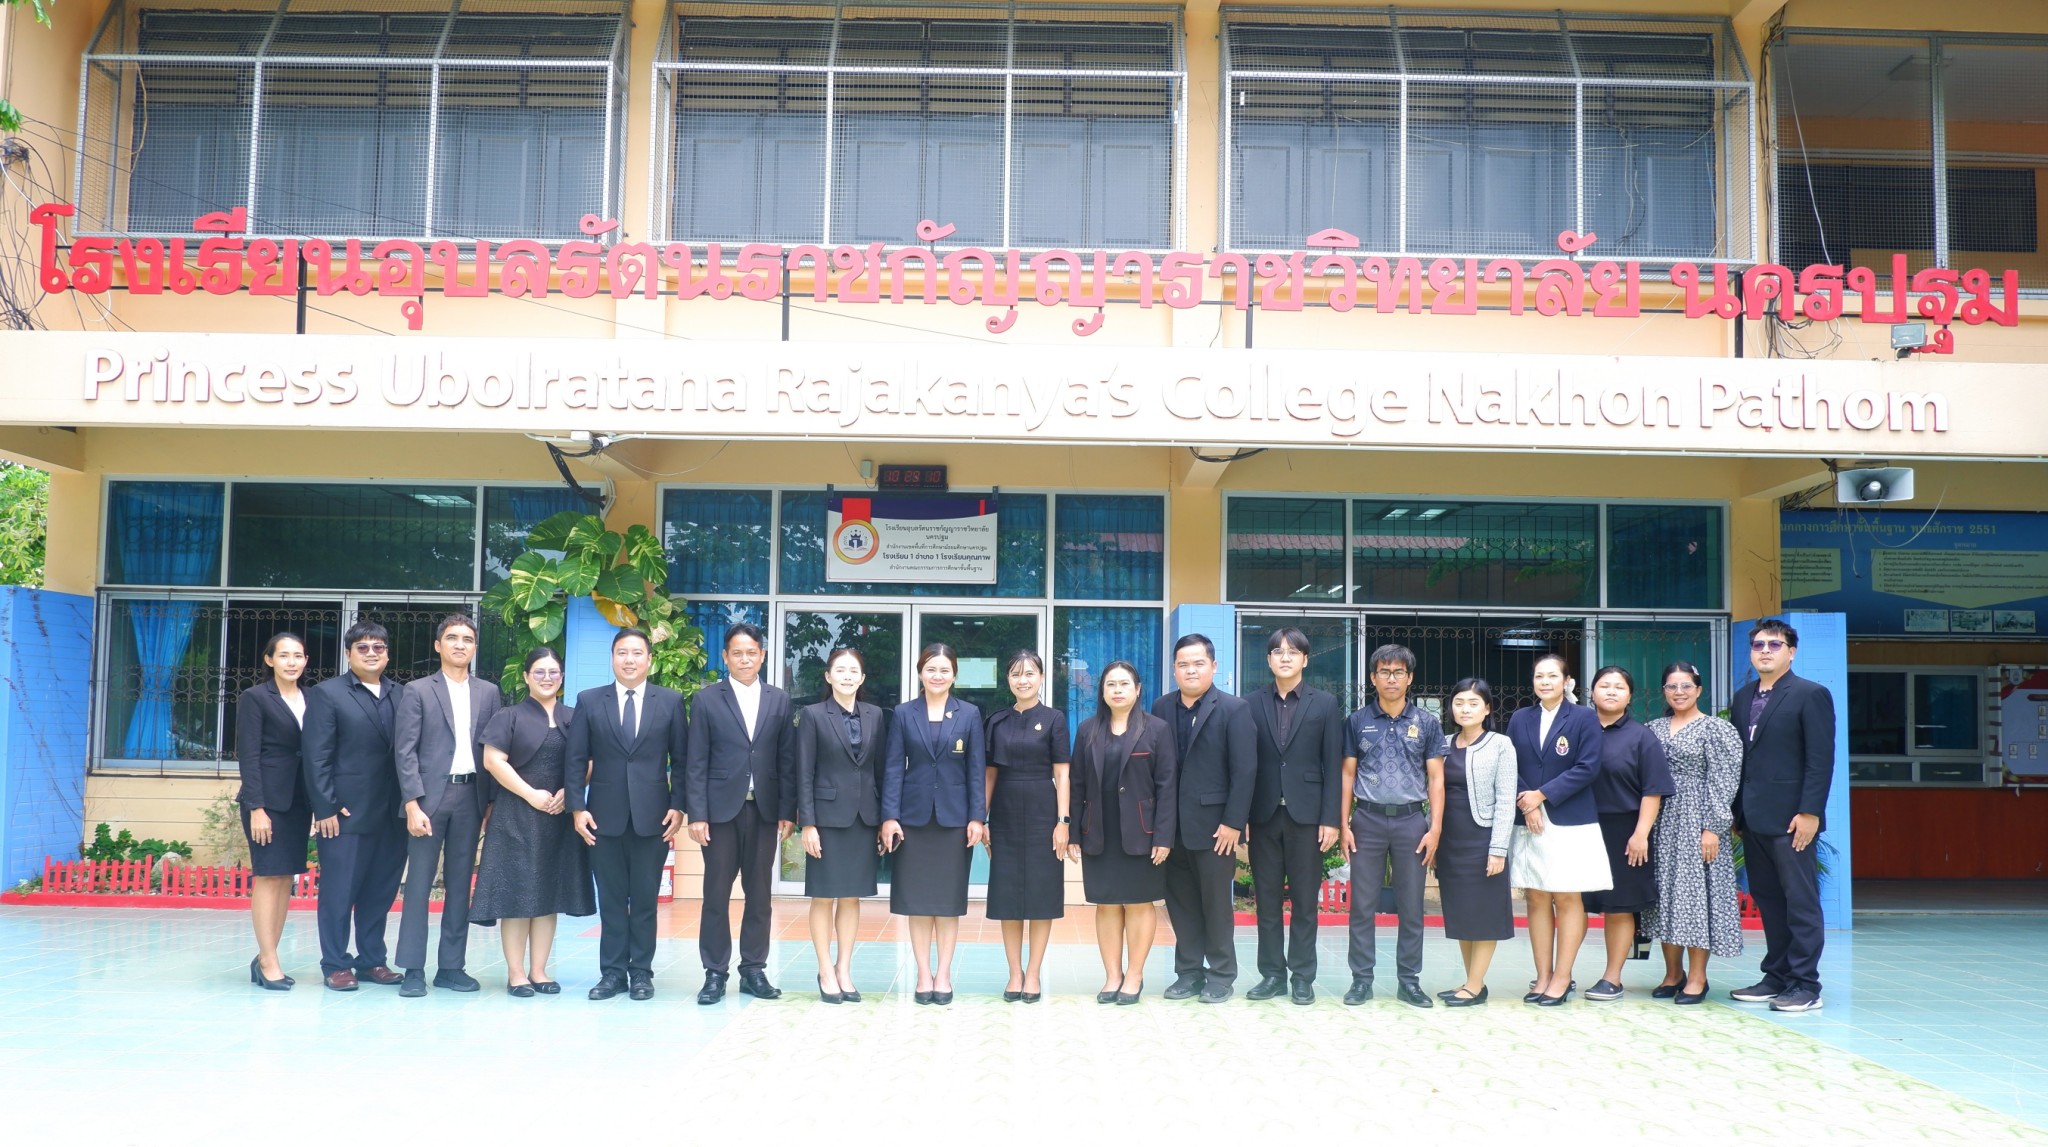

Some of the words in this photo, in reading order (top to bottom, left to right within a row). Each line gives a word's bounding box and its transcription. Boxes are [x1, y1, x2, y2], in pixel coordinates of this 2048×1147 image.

[29, 203, 1641, 336] โรงเรียนอุบลรัตนราชกัญญาราชวิทยาลัย
[1670, 253, 2019, 355] นครปฐม
[83, 347, 359, 406] Princess
[381, 350, 748, 415] Ubolratana
[766, 361, 1140, 431] Rajakanya's
[1161, 364, 1408, 437] College
[1427, 368, 1682, 427] Nakhon
[1699, 371, 1949, 433] Pathom
[1969, 524, 1996, 534] 2551
[926, 534, 949, 542] นครปฐม
[883, 552, 909, 560] โรงเรียน
[915, 552, 934, 560] อำเภอ
[941, 552, 991, 562] โรงเรียนคุณภาพ
